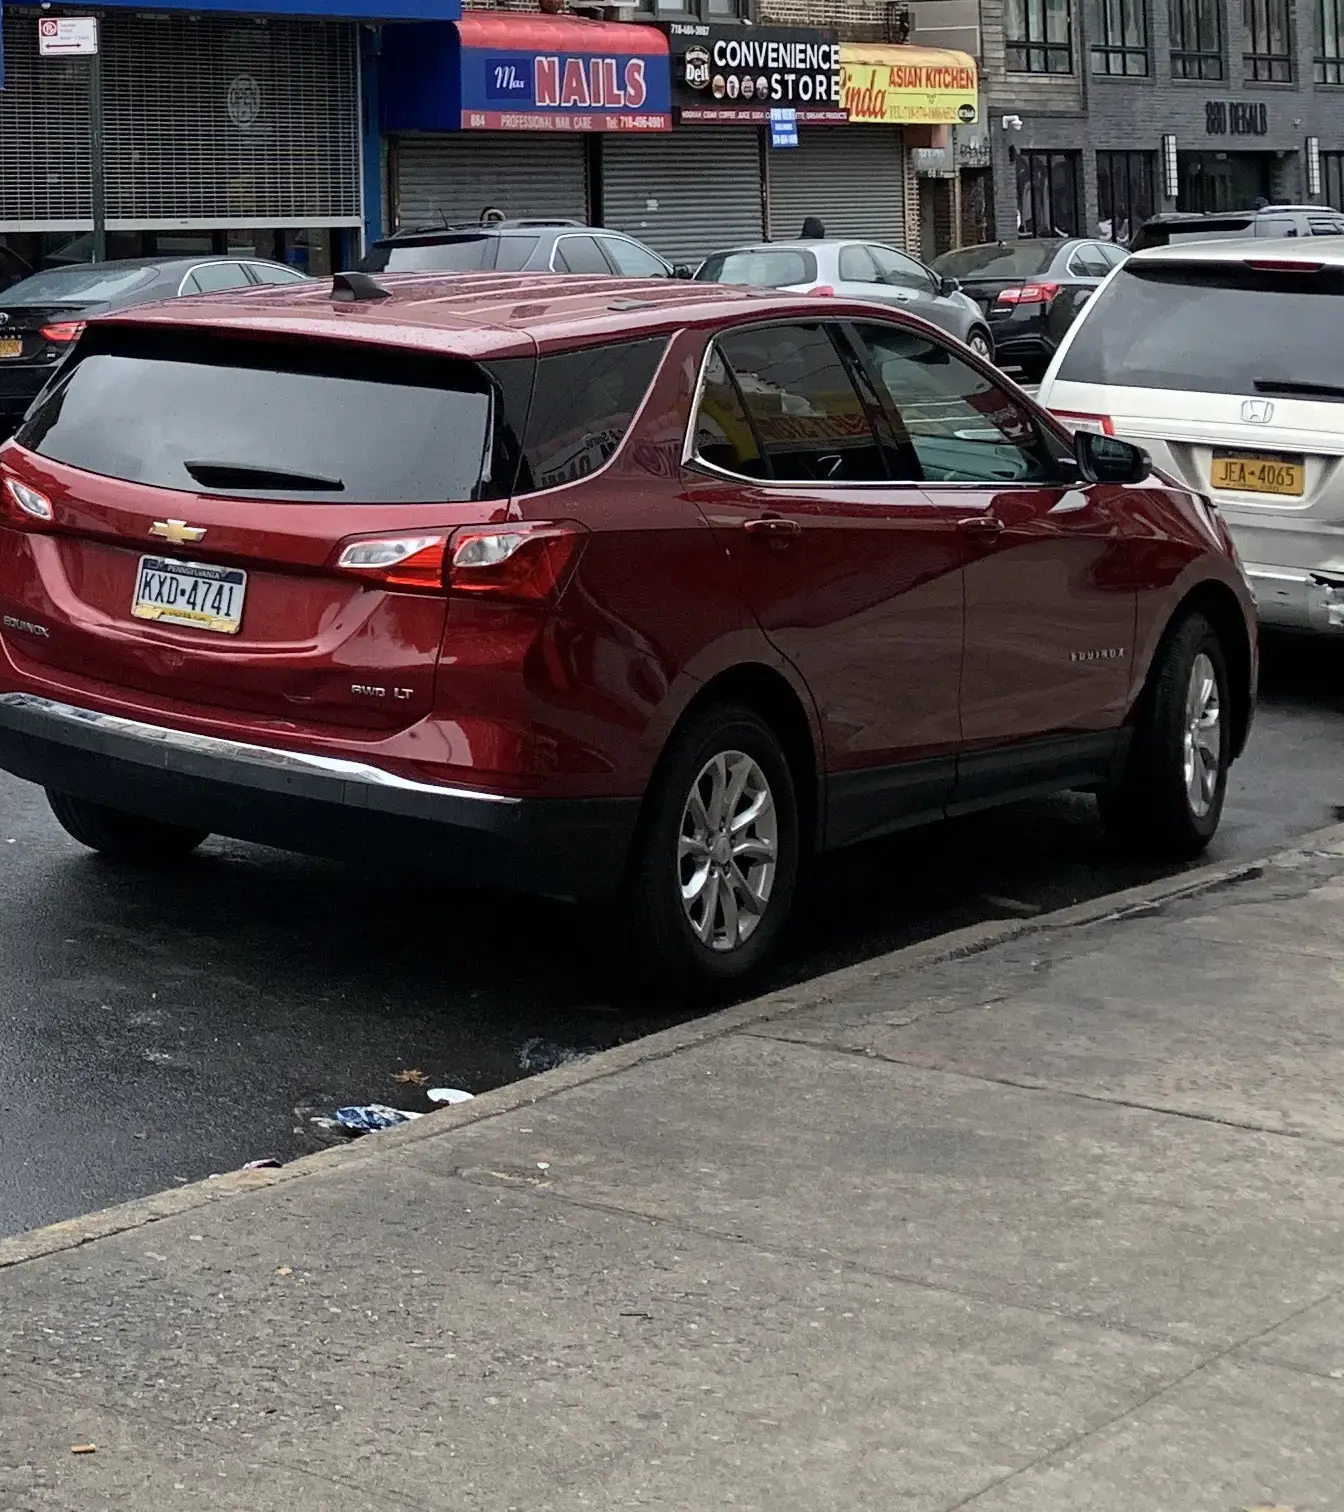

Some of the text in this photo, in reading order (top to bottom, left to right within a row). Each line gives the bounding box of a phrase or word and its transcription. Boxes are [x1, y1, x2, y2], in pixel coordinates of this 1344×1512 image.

[713, 40, 840, 71] CONVENIENCE
[534, 56, 647, 108] NAILS
[686, 63, 710, 82] Deli
[888, 67, 975, 90] ASIAN KITCHEN
[770, 72, 841, 101] STORE
[500, 113, 553, 129] PROFESSIONAL
[3, 615, 50, 638] EQUINOX
[393, 687, 414, 699] LT
